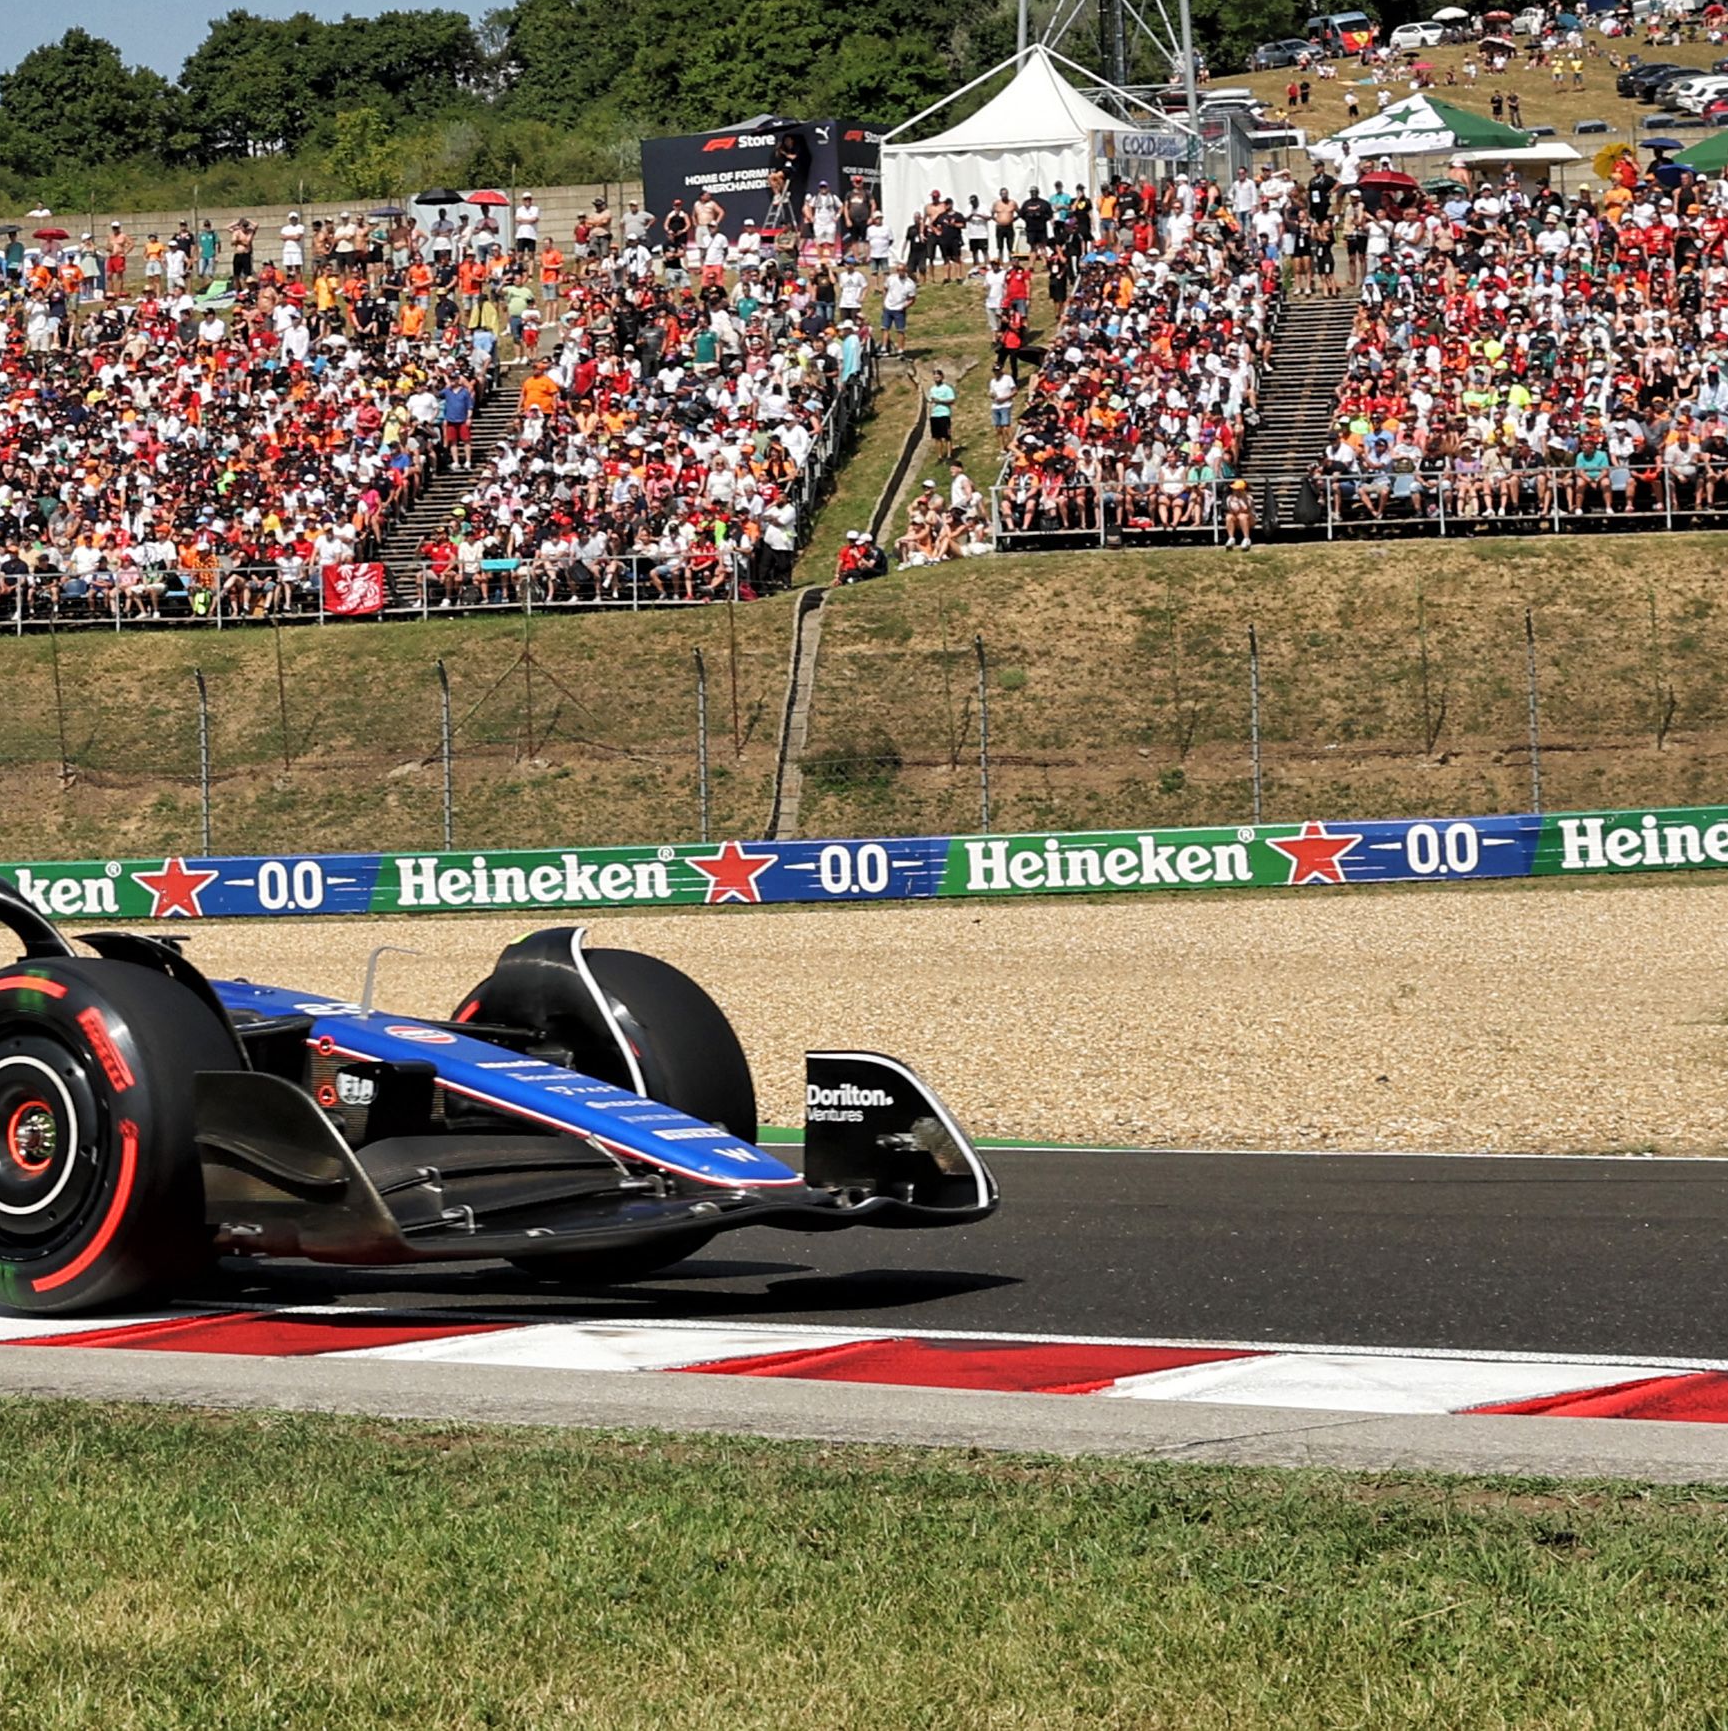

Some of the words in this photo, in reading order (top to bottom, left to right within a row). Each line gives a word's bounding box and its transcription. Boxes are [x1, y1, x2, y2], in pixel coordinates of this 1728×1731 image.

[738, 135, 776, 148] Store
[685, 174, 718, 186] HOME
[719, 171, 734, 182] OF
[735, 168, 776, 181] FORM
[702, 180, 771, 194] MERCHANDI
[819, 844, 889, 893] 0.0
[965, 836, 1253, 890] Heineken
[1406, 823, 1479, 874] 0.0
[258, 861, 323, 910] 0.0
[395, 855, 673, 906] Heineken
[807, 1108, 864, 1122] Ventures
